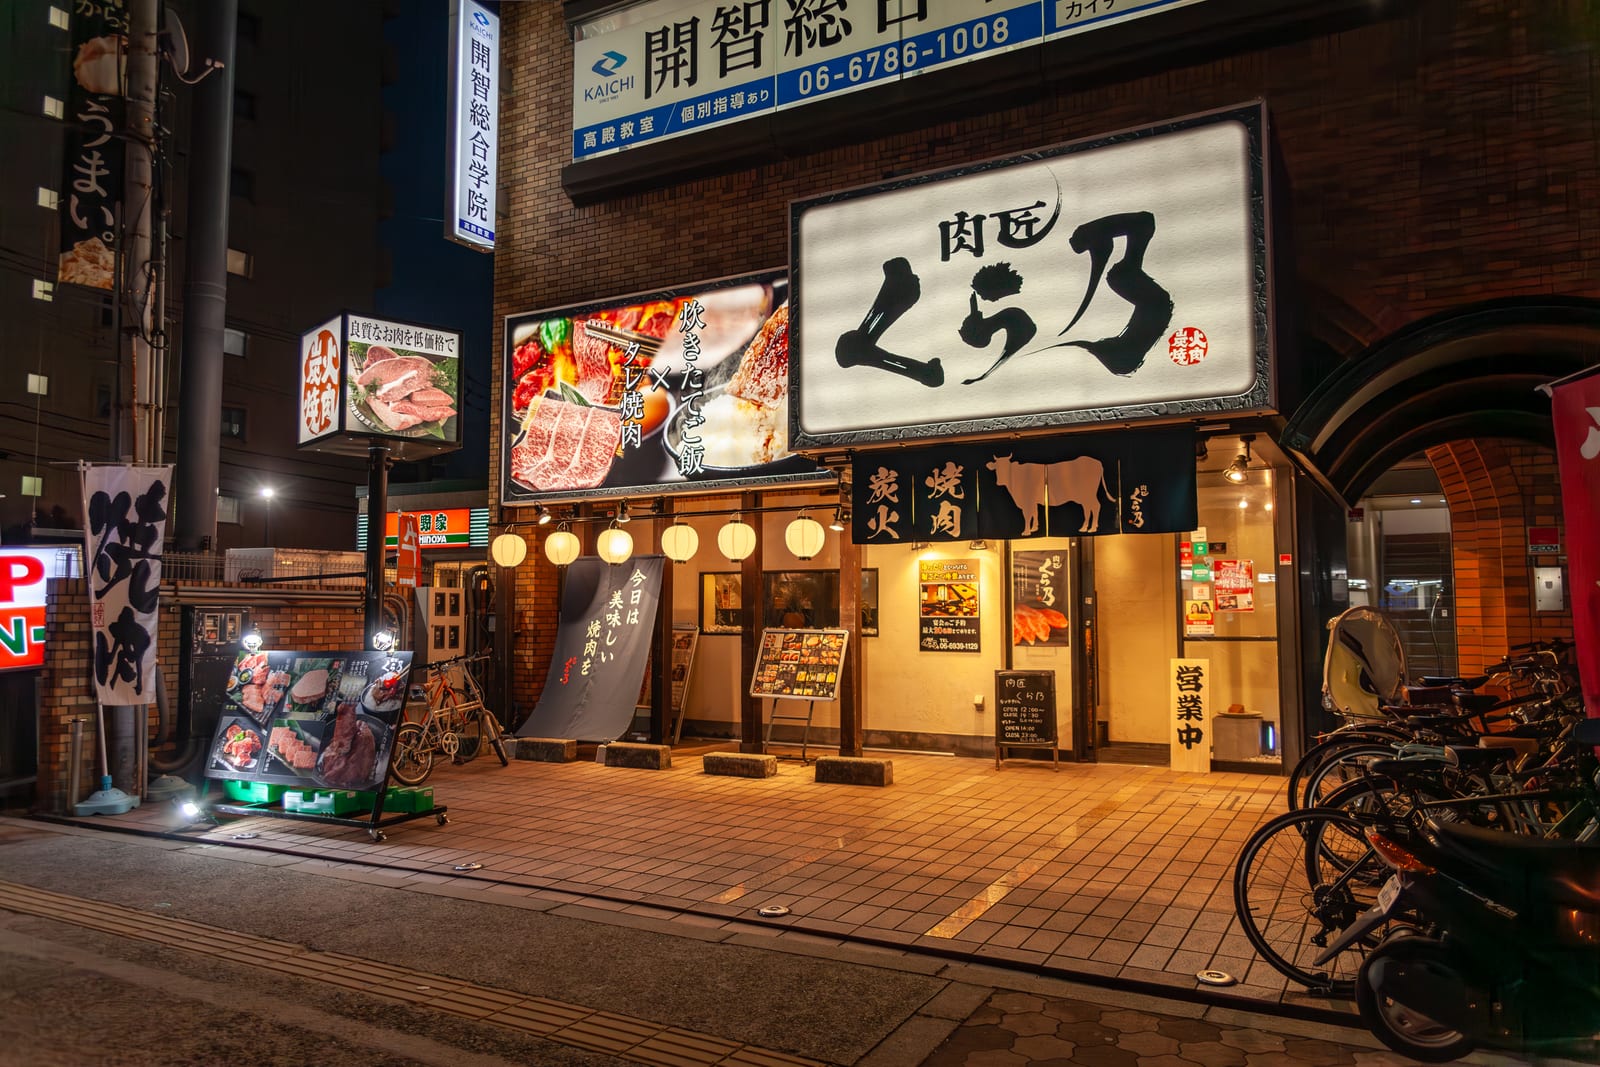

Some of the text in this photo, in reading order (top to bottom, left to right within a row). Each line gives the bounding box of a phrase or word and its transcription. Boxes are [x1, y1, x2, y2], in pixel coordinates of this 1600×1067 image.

[469, 20, 493, 40] KAICHI
[798, 16, 1009, 95] 06-6786-1008
[584, 75, 635, 102] KAICHI
[681, 89, 769, 123] 個別指導あり
[468, 37, 491, 222] 開智総合学院
[583, 116, 654, 149] 高殿教室
[938, 163, 1061, 262] 肉匠
[835, 211, 1174, 387] くら乃
[350, 319, 455, 353] 良質なお肉を低価格で
[619, 341, 645, 450] タレ焼肉
[679, 299, 707, 476] 炊きたてご飯
[866, 466, 900, 539] 炭火
[925, 461, 964, 538] 焼肉
[626, 569, 647, 625] 今日は
[1039, 558, 1056, 606] くら乃
[581, 620, 601, 675] 焼肉を
[601, 590, 624, 663] 美味しい
[1176, 665, 1204, 750] 営業中
